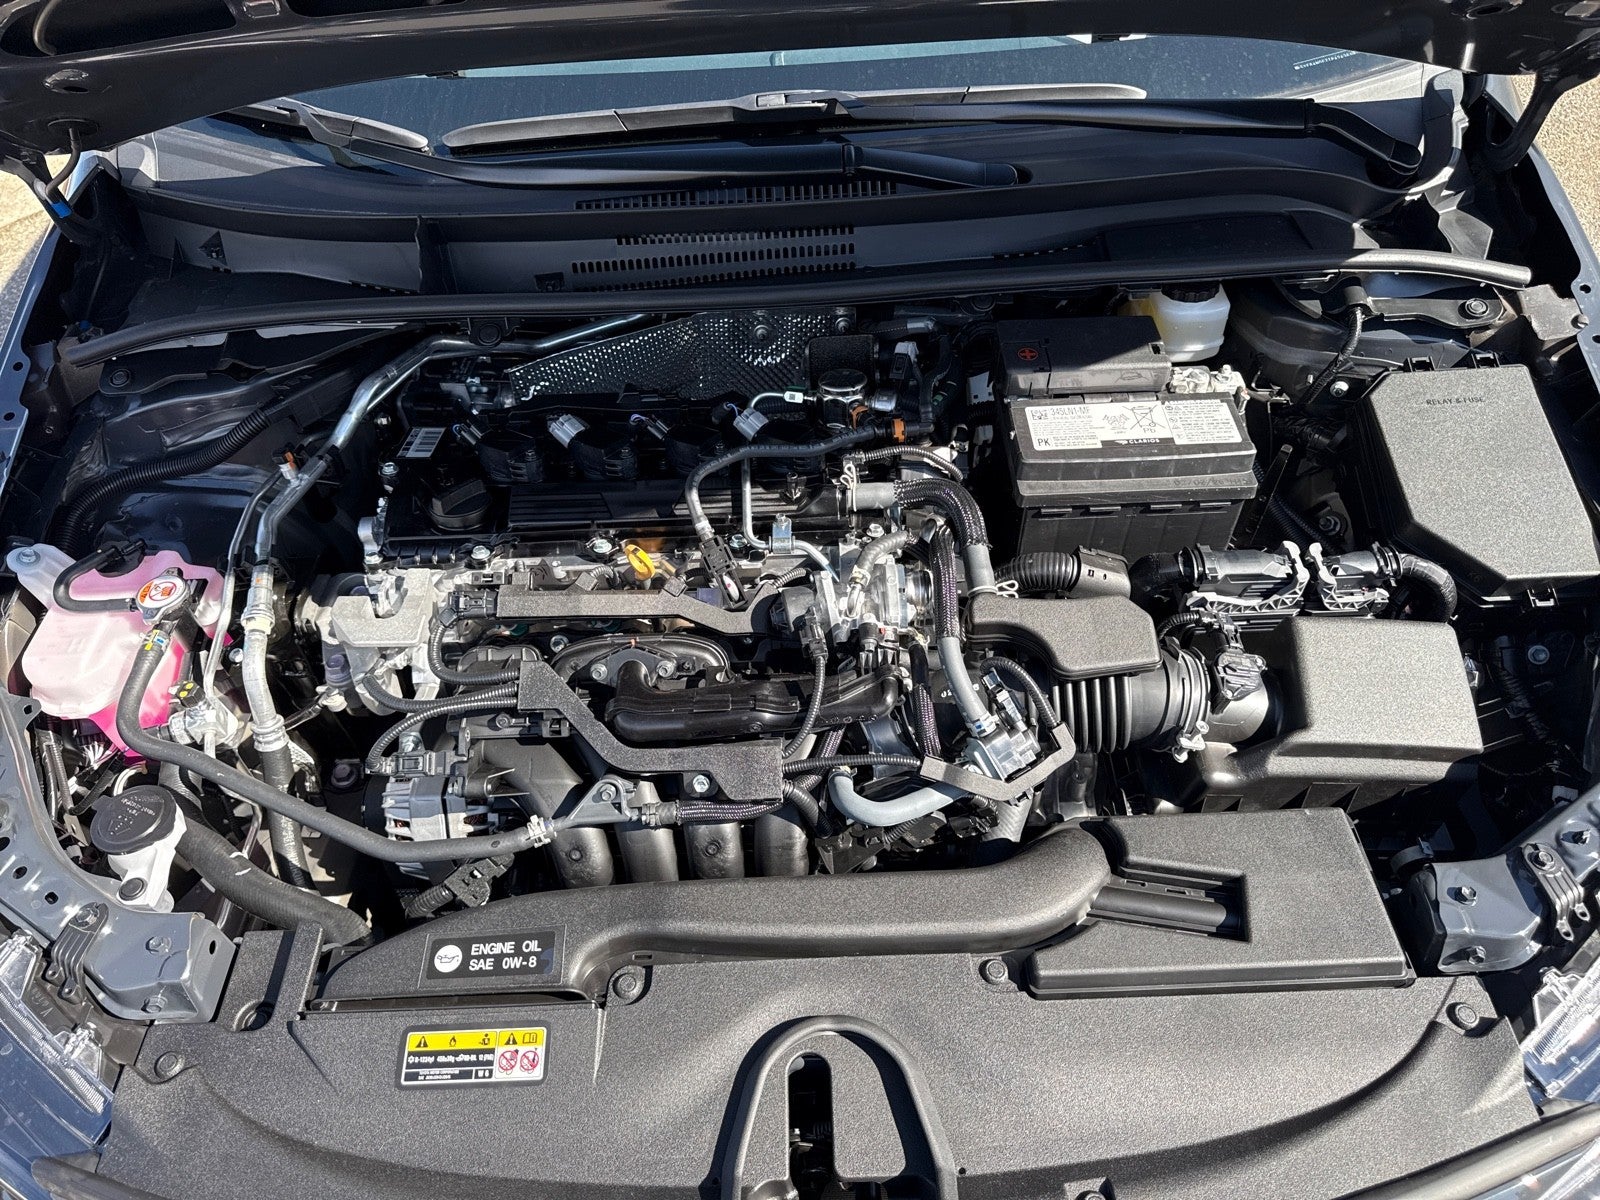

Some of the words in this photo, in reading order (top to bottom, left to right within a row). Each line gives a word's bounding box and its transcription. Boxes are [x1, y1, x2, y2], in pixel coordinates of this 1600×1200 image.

[1037, 438, 1051, 447] PK
[470, 941, 515, 956] ENGINE
[522, 939, 542, 953] OIL
[468, 957, 495, 971] SAE
[502, 955, 537, 969] 0W-8
